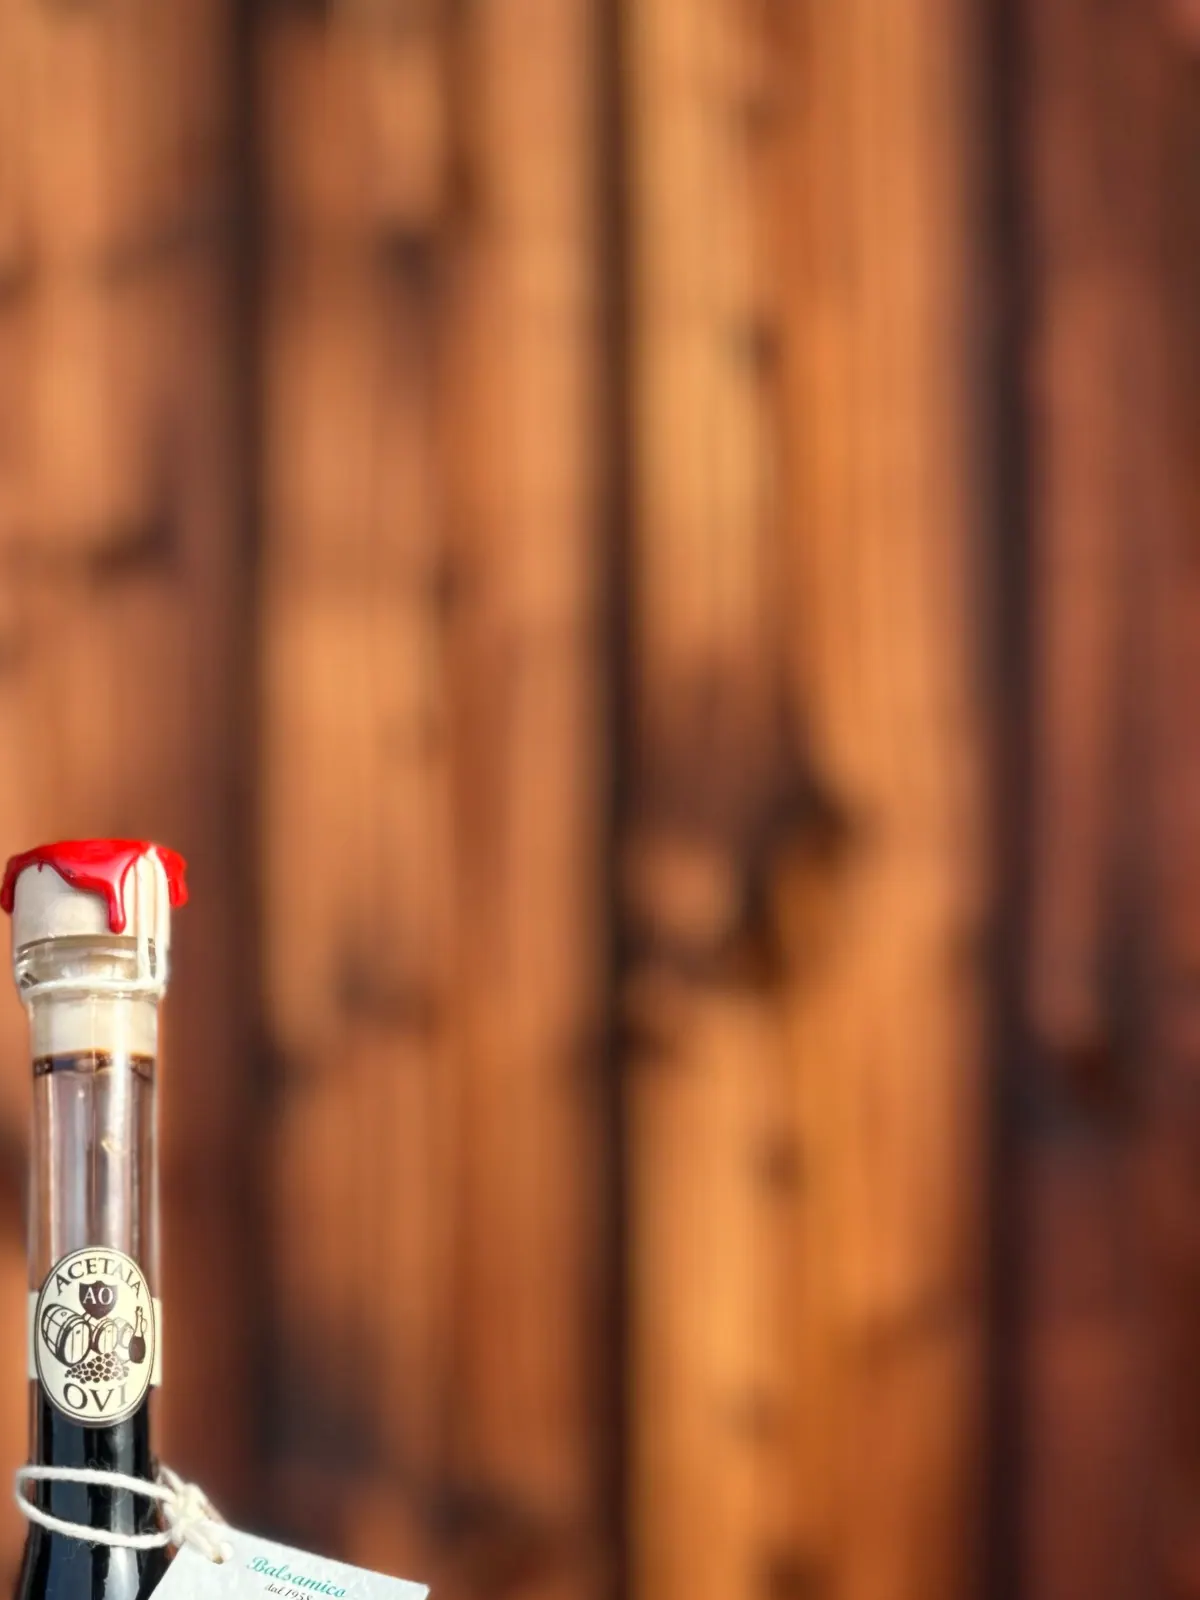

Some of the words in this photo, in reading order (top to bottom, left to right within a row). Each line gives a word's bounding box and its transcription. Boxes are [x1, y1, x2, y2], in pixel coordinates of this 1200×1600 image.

[55, 1258, 142, 1299] ACETAIA
[83, 1286, 114, 1305] AO
[63, 1382, 129, 1412] OVI
[246, 1556, 346, 1598] Balsamico
[264, 1582, 284, 1595] dal
